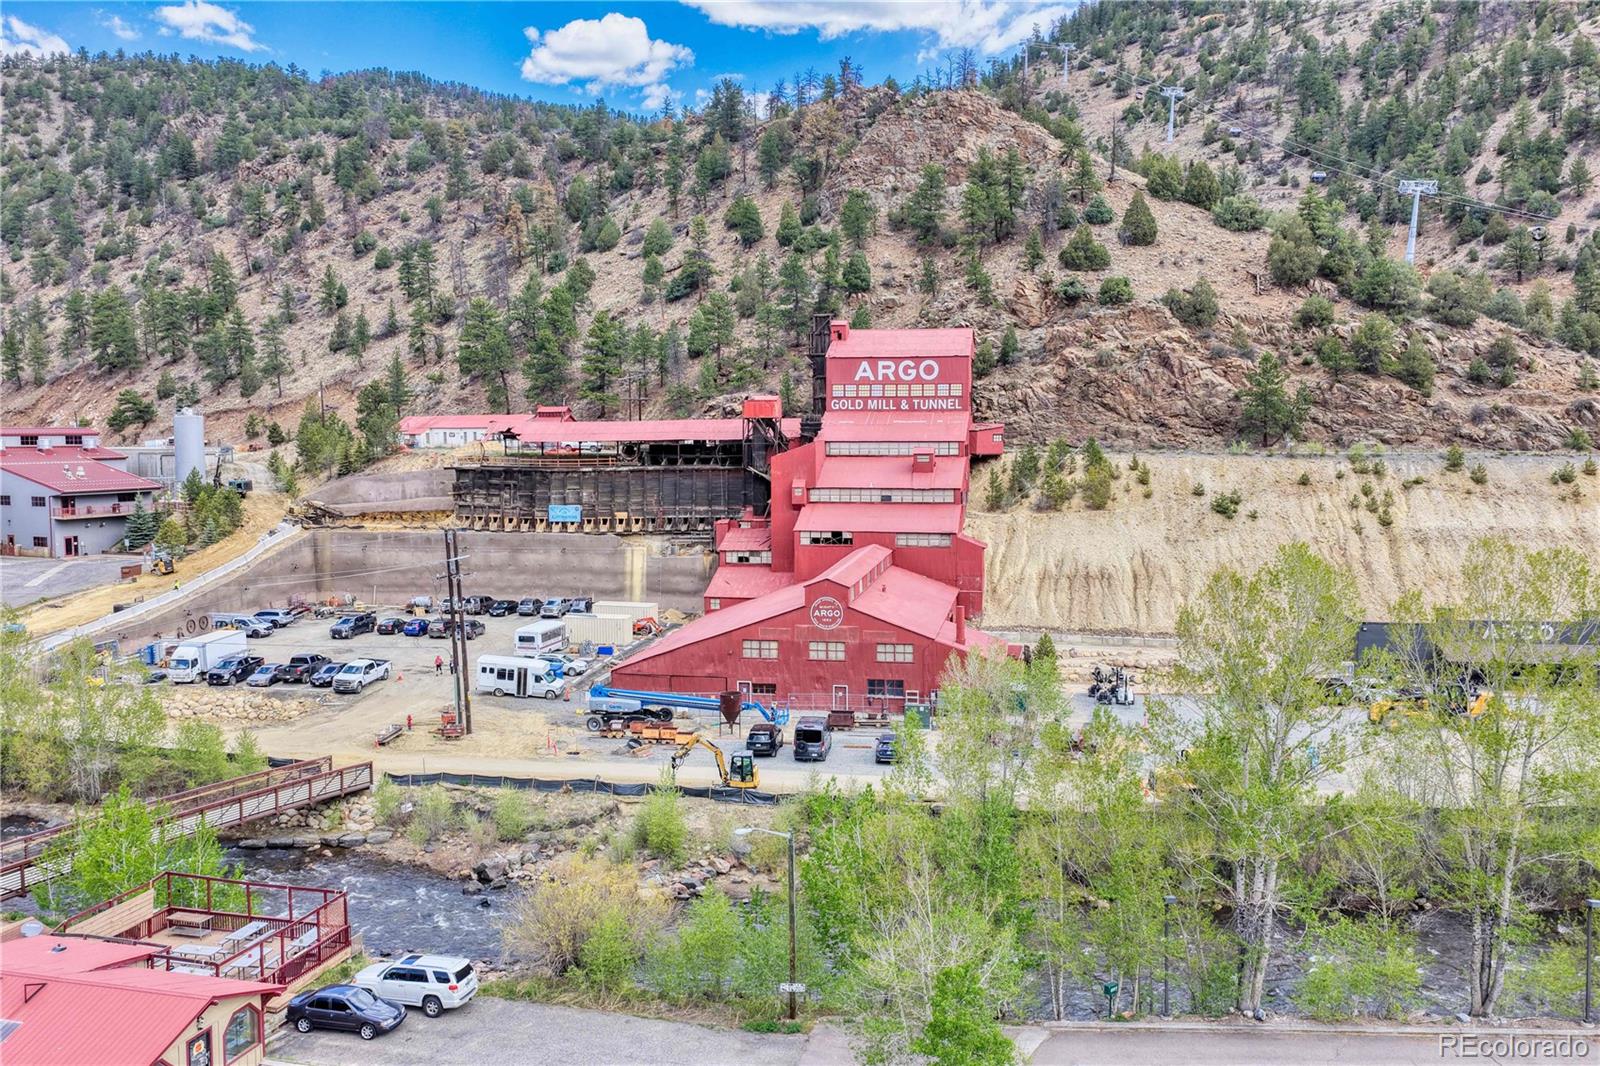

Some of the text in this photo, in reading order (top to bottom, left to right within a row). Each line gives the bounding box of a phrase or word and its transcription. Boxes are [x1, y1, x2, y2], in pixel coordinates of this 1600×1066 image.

[854, 359, 939, 381] ARGO
[831, 398, 962, 410] GOLD MILL & TUNNEL
[813, 609, 841, 617] ARGO
